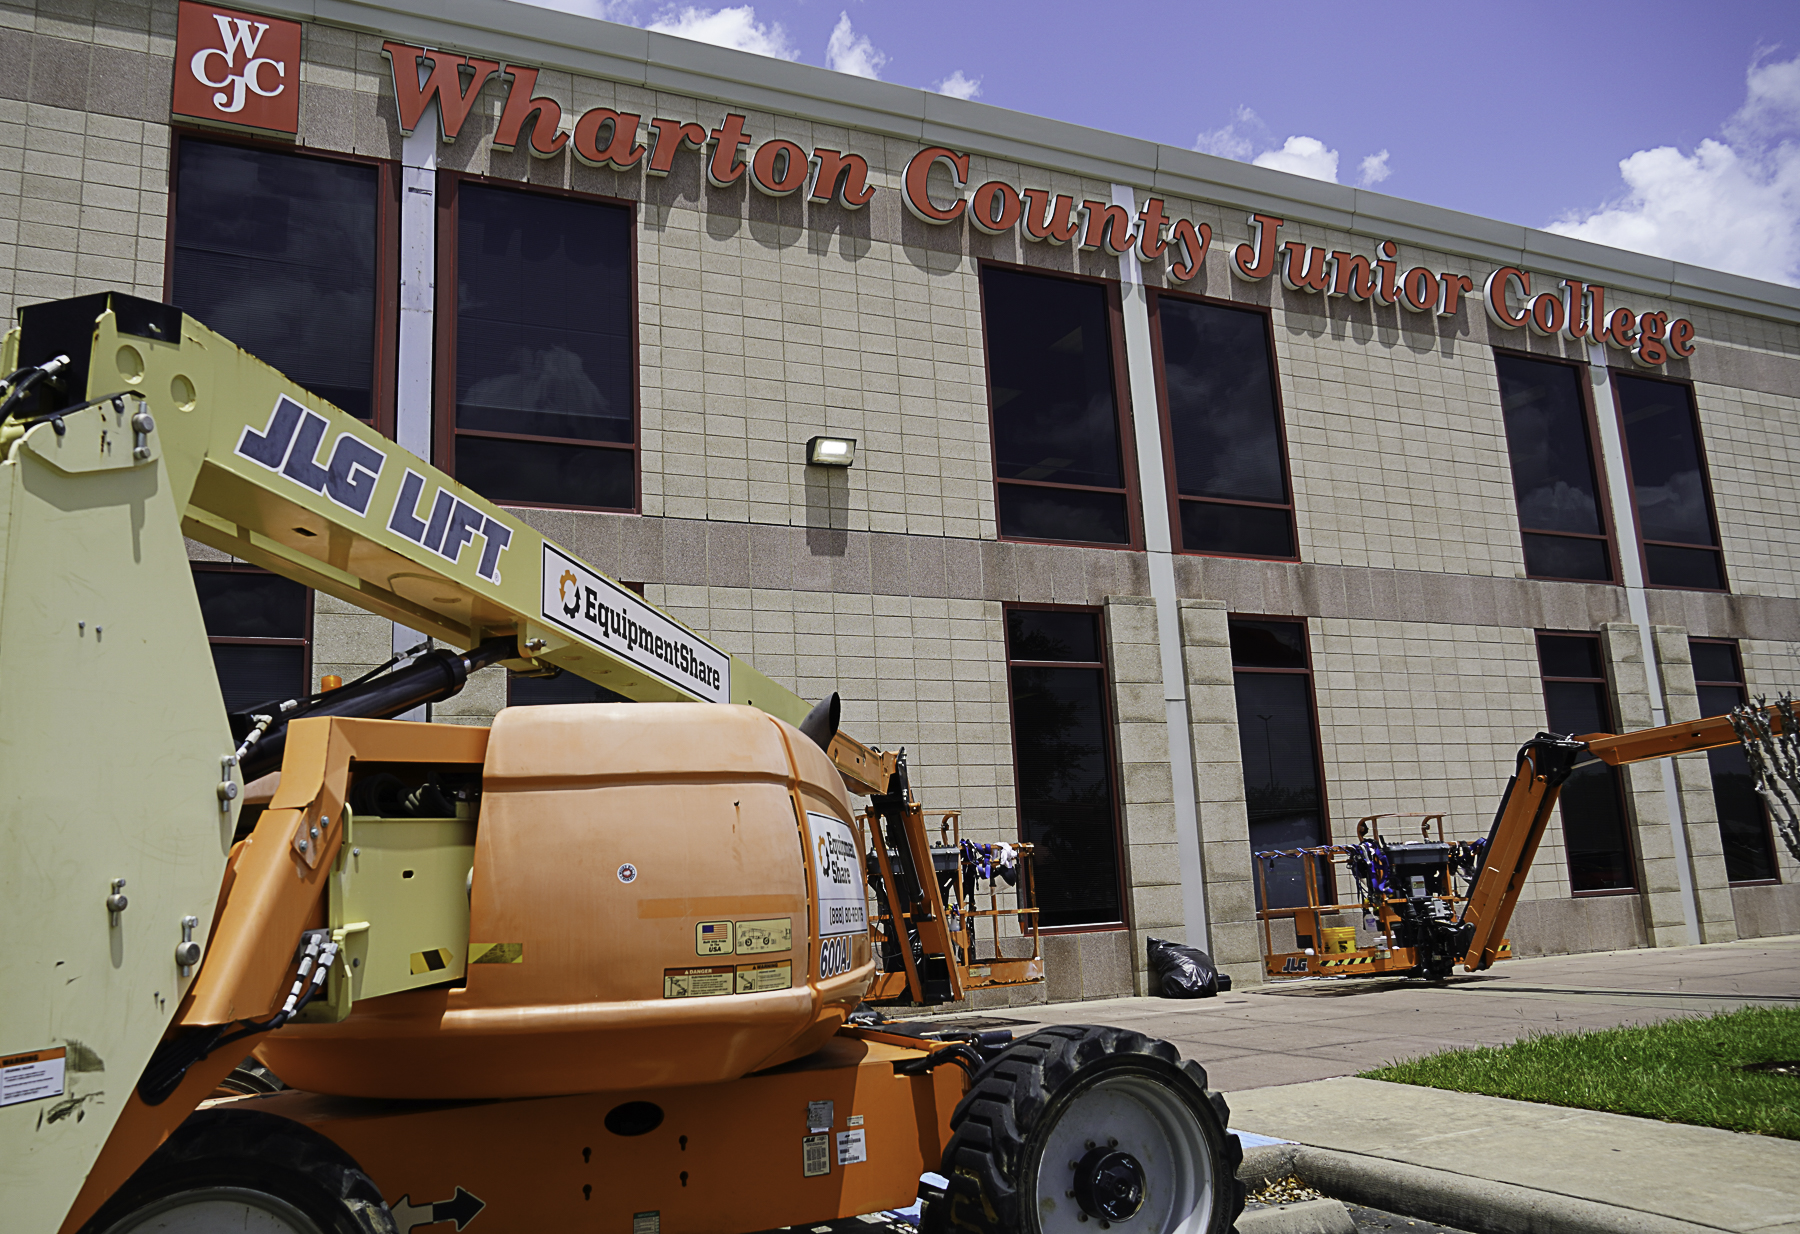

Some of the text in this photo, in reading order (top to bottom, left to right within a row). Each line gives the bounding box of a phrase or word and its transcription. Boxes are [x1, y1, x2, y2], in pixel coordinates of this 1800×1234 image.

[381, 40, 1696, 367] Wharton County Junior College
[234, 393, 514, 585] JLG LIFT
[585, 585, 720, 691] EquipmentShare
[832, 860, 851, 884] Share
[829, 906, 844, 926] (888)
[820, 935, 852, 979] 600AJ
[1282, 956, 1308, 972] JLG
[2, 1054, 39, 1066] WARNING
